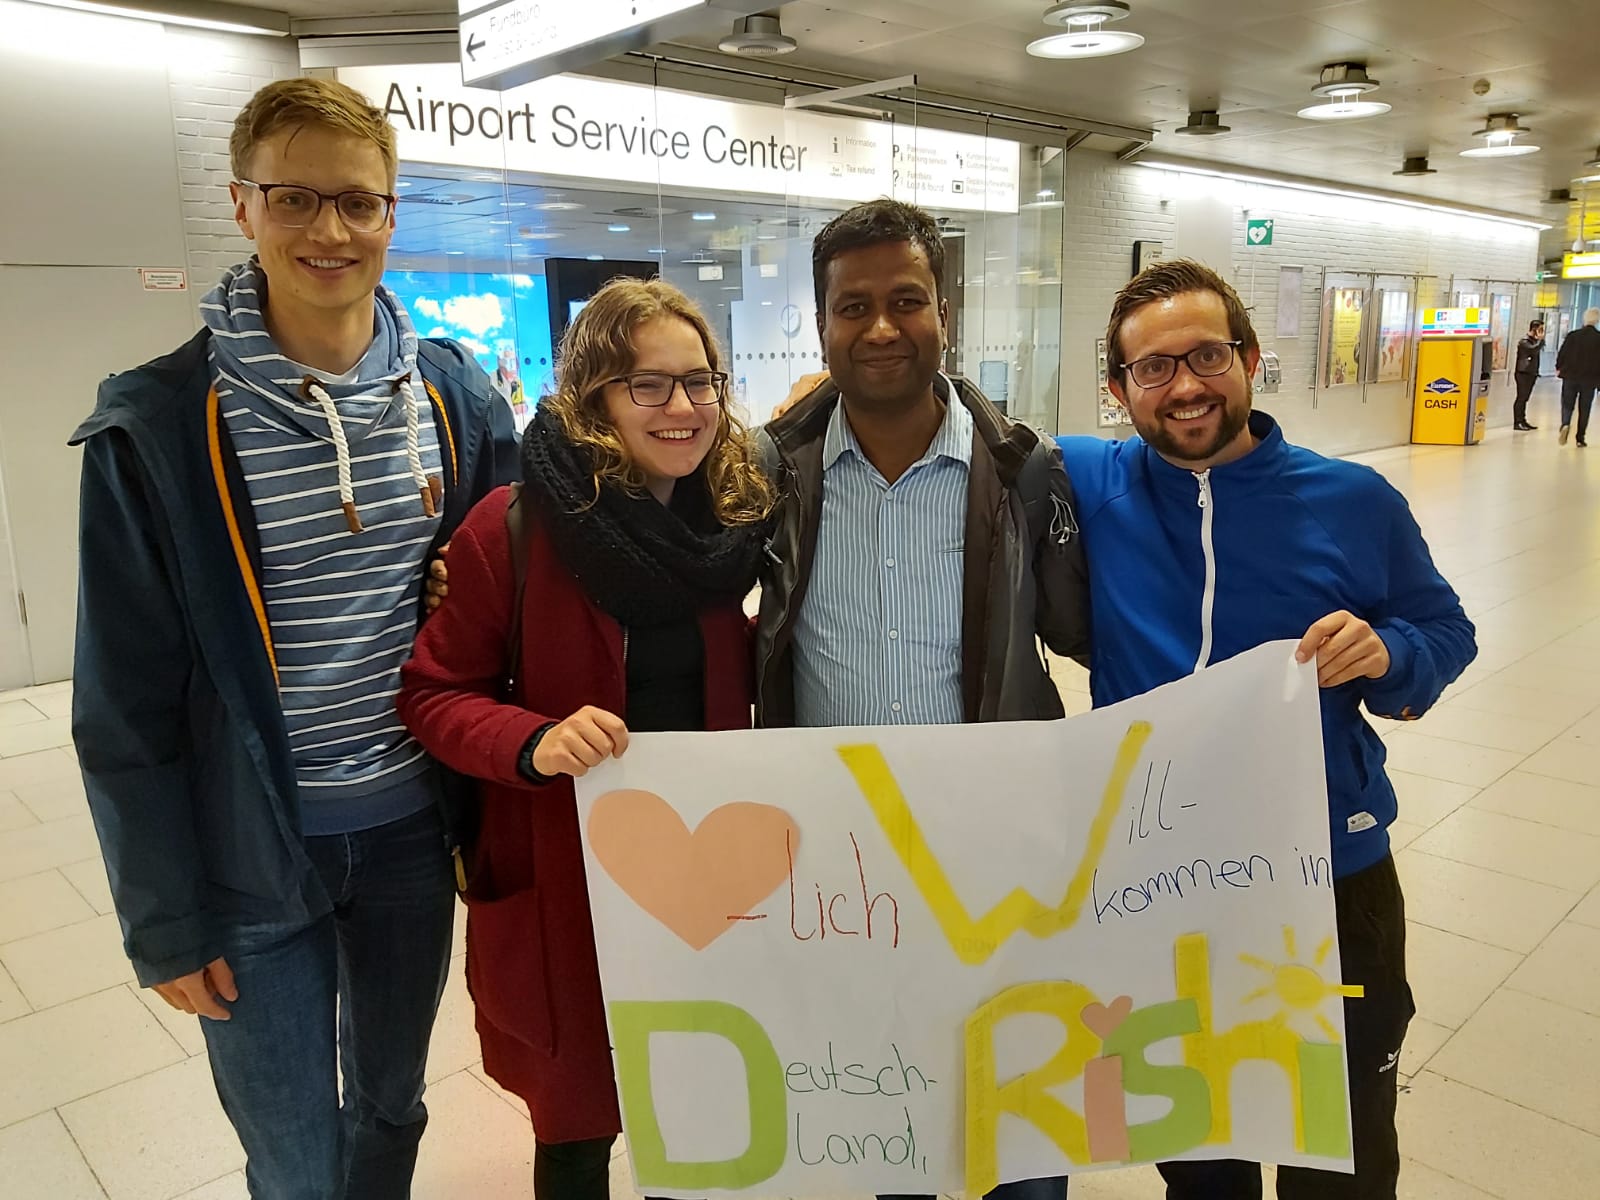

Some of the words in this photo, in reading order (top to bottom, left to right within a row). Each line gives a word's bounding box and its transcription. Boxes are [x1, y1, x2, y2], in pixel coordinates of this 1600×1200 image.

[384, 82, 536, 146] Airport
[552, 105, 690, 160] Service
[703, 125, 808, 172] Center
[1424, 399, 1458, 409] CASH
[1093, 854, 1274, 924] kommen
[1296, 847, 1333, 888] in
[965, 932, 1351, 1199] Rishi
